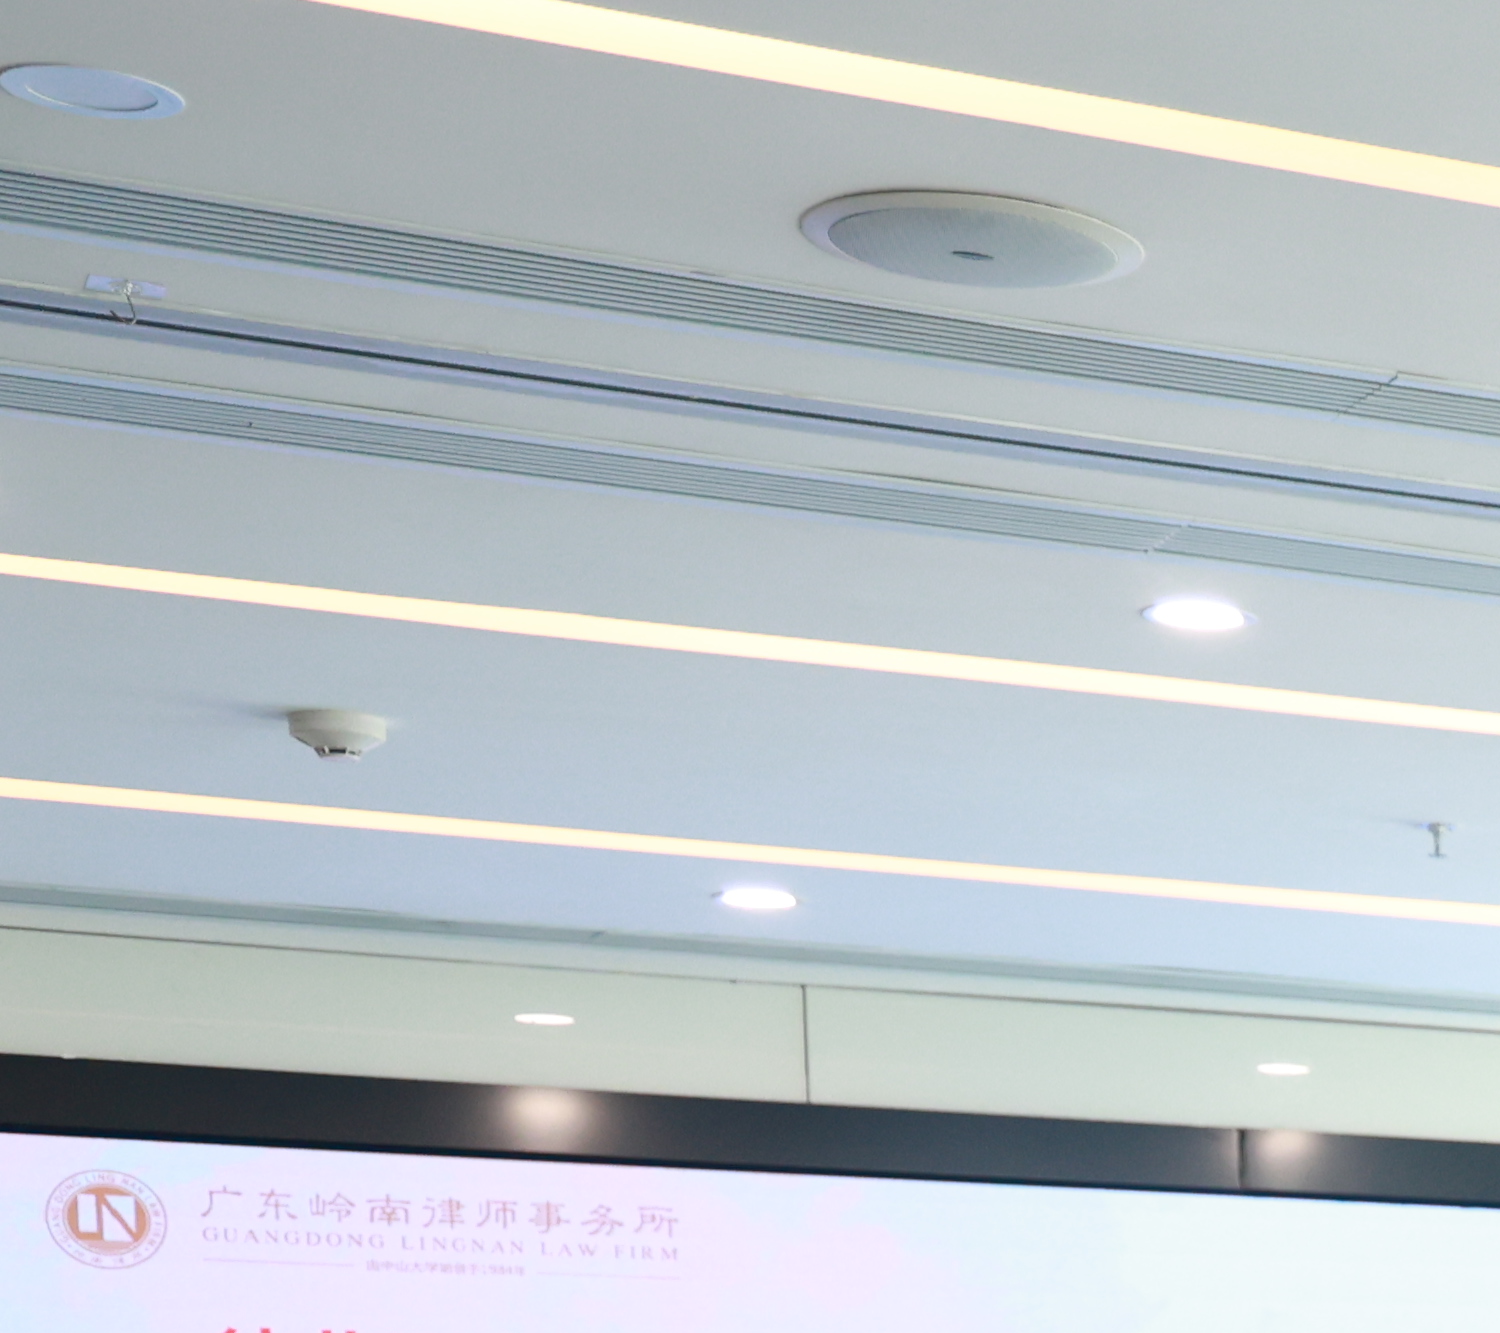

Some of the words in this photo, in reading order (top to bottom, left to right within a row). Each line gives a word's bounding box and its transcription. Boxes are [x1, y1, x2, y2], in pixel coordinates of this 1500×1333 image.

[202, 1185, 679, 1238] 广东岭南律师事务所
[202, 1226, 385, 1251] GUANGDONG
[401, 1234, 525, 1255] LINGNAN
[540, 1241, 599, 1258] LAW
[614, 1243, 679, 1261] FIRM
